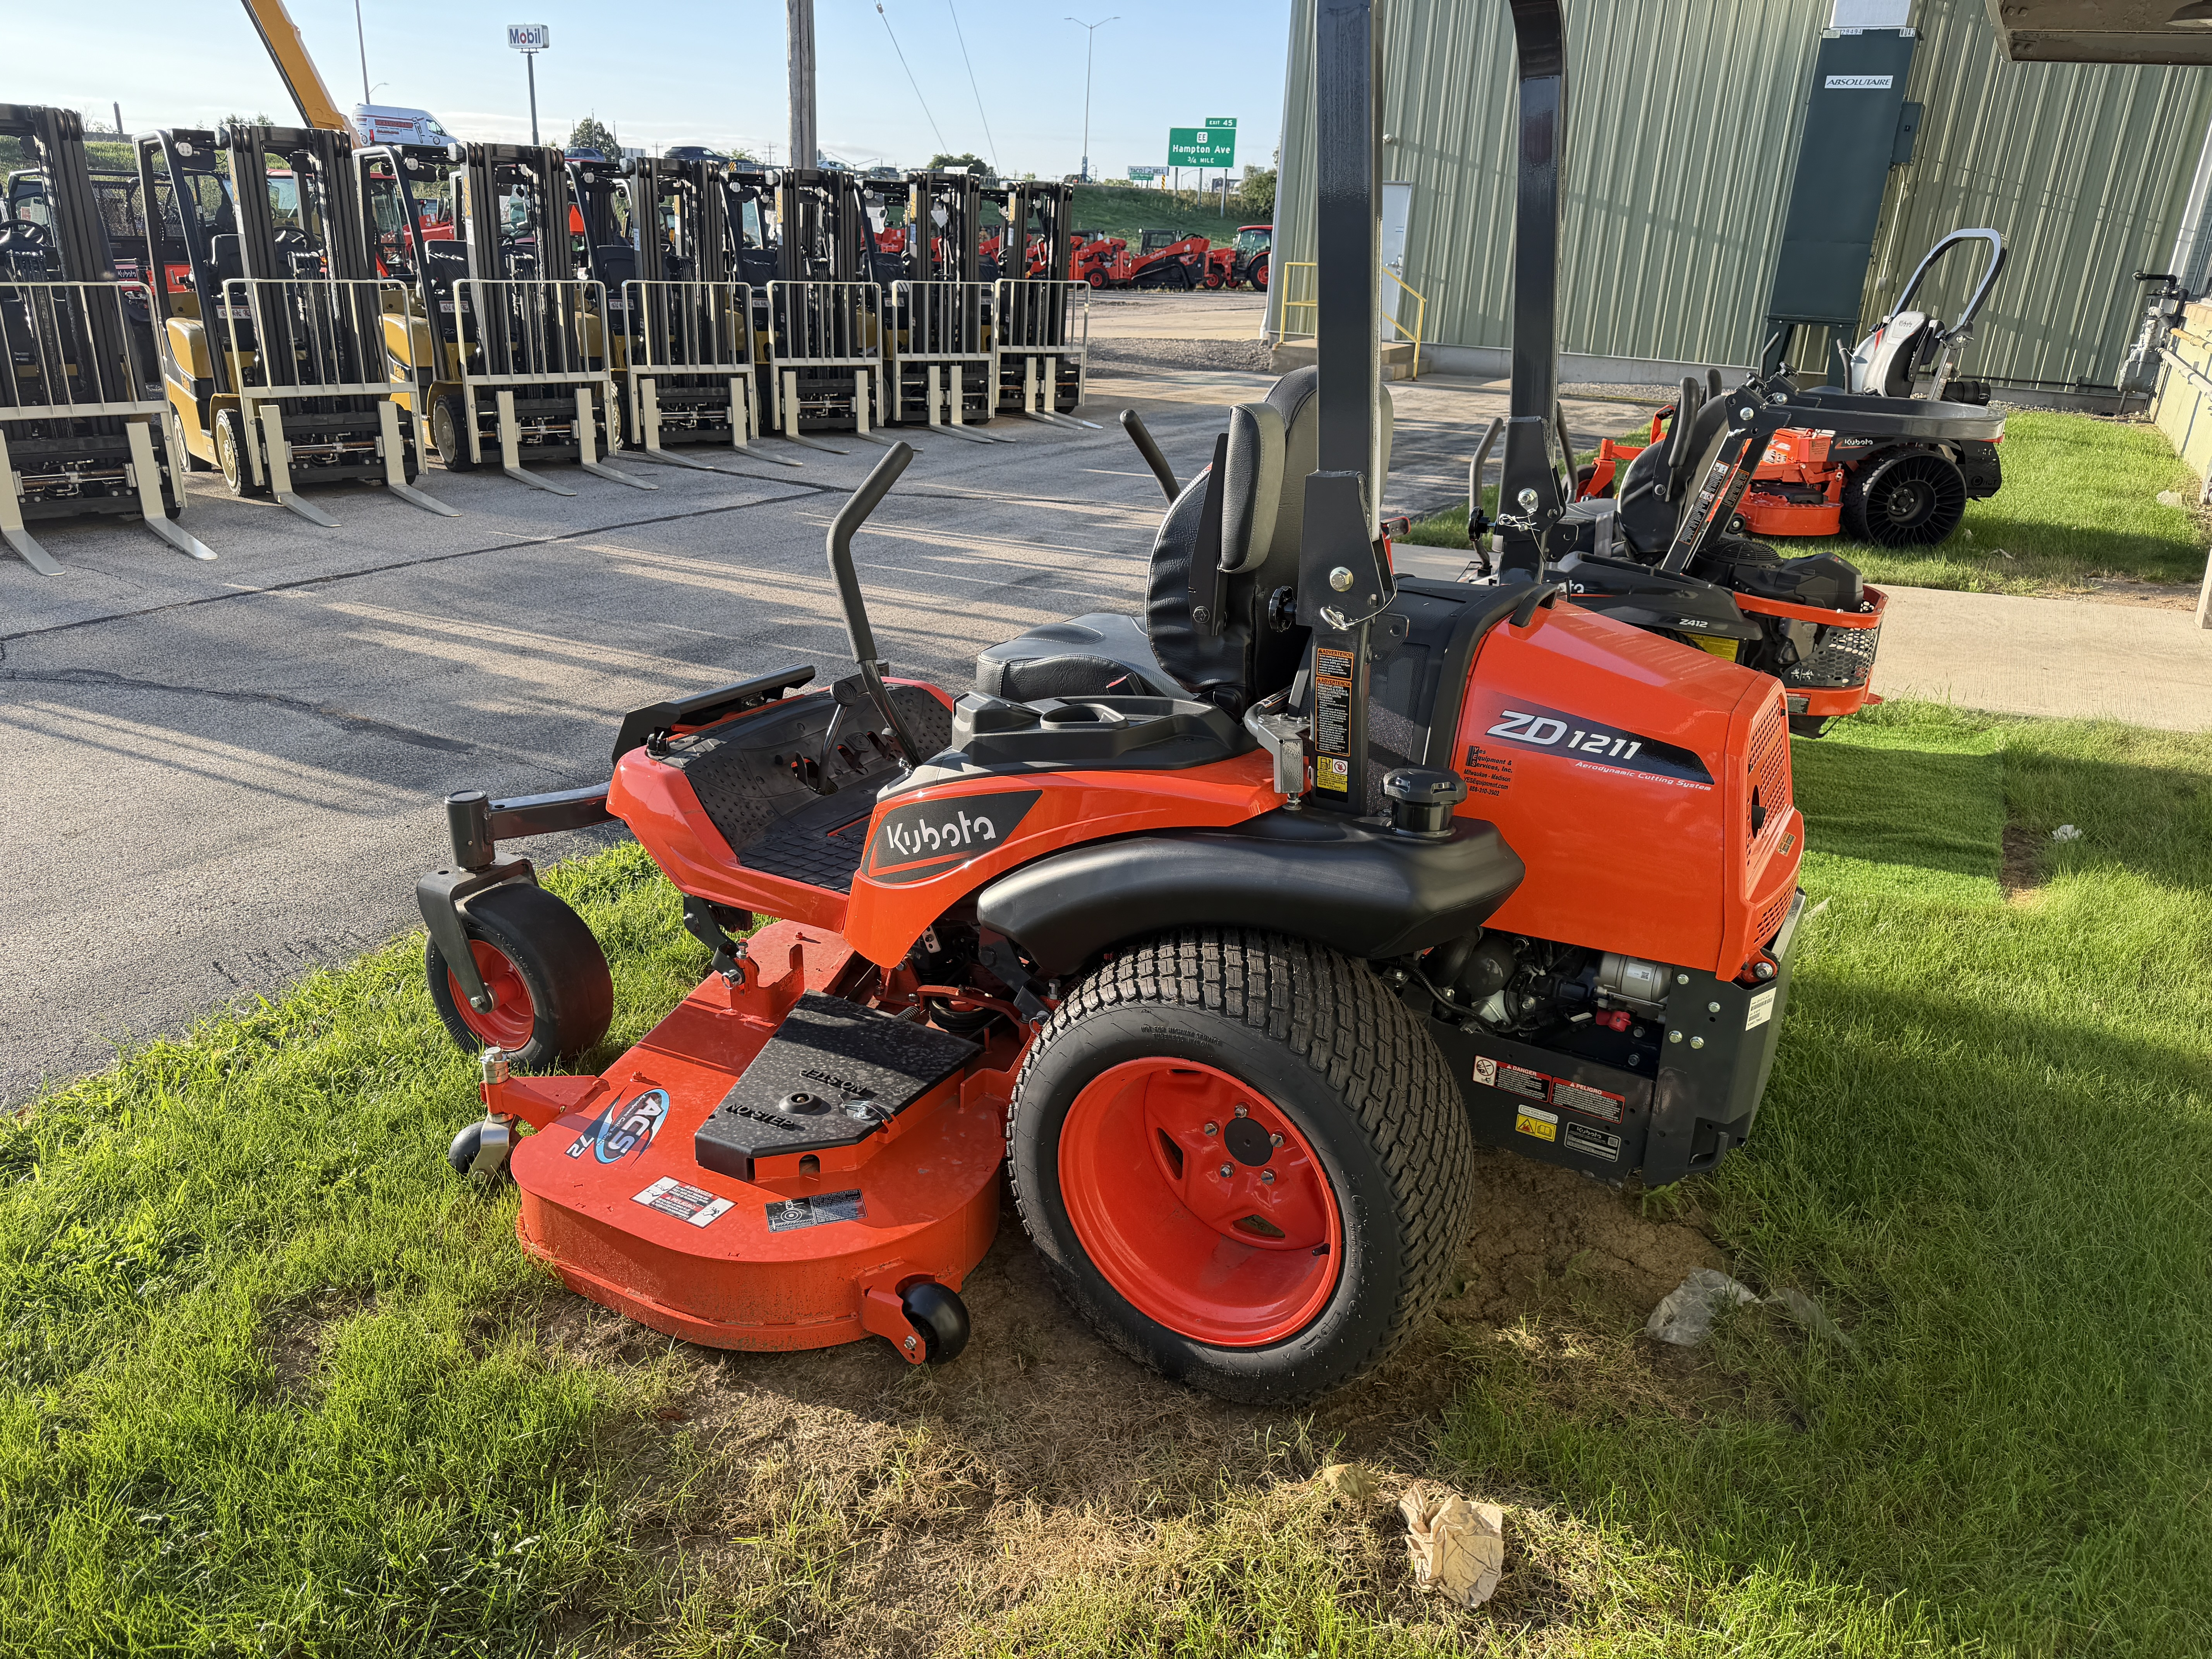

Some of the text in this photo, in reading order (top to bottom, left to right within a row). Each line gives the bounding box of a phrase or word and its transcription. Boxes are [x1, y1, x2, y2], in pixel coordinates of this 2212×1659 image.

[510, 27, 541, 44] Mobil
[1173, 144, 1231, 155] Hampton Ave
[117, 270, 137, 278] Kubota
[1679, 618, 1708, 628] Z412
[1322, 649, 1353, 658] ADVERTENCIA
[1491, 774, 1511, 782] Madison
[1575, 761, 1712, 791] Aerodynamic Cutting System
[887, 811, 996, 855] Kubota
[1152, 1033, 1183, 1041] TUBELESS
[1168, 1027, 1194, 1037] HIGHWAY
[1195, 1032, 1221, 1045] SERVICE
[1513, 1065, 1537, 1076] DANGER
[799, 1069, 868, 1095] NO STEP
[1576, 1083, 1602, 1095] PELIGRO
[725, 1103, 795, 1129] NO STEP
[608, 1096, 662, 1154] ACS
[1577, 1126, 1602, 1139] Kubota
[566, 1135, 595, 1157] 72
[689, 1185, 714, 1198] DANGER
[671, 1197, 696, 1209] PELIGRO
